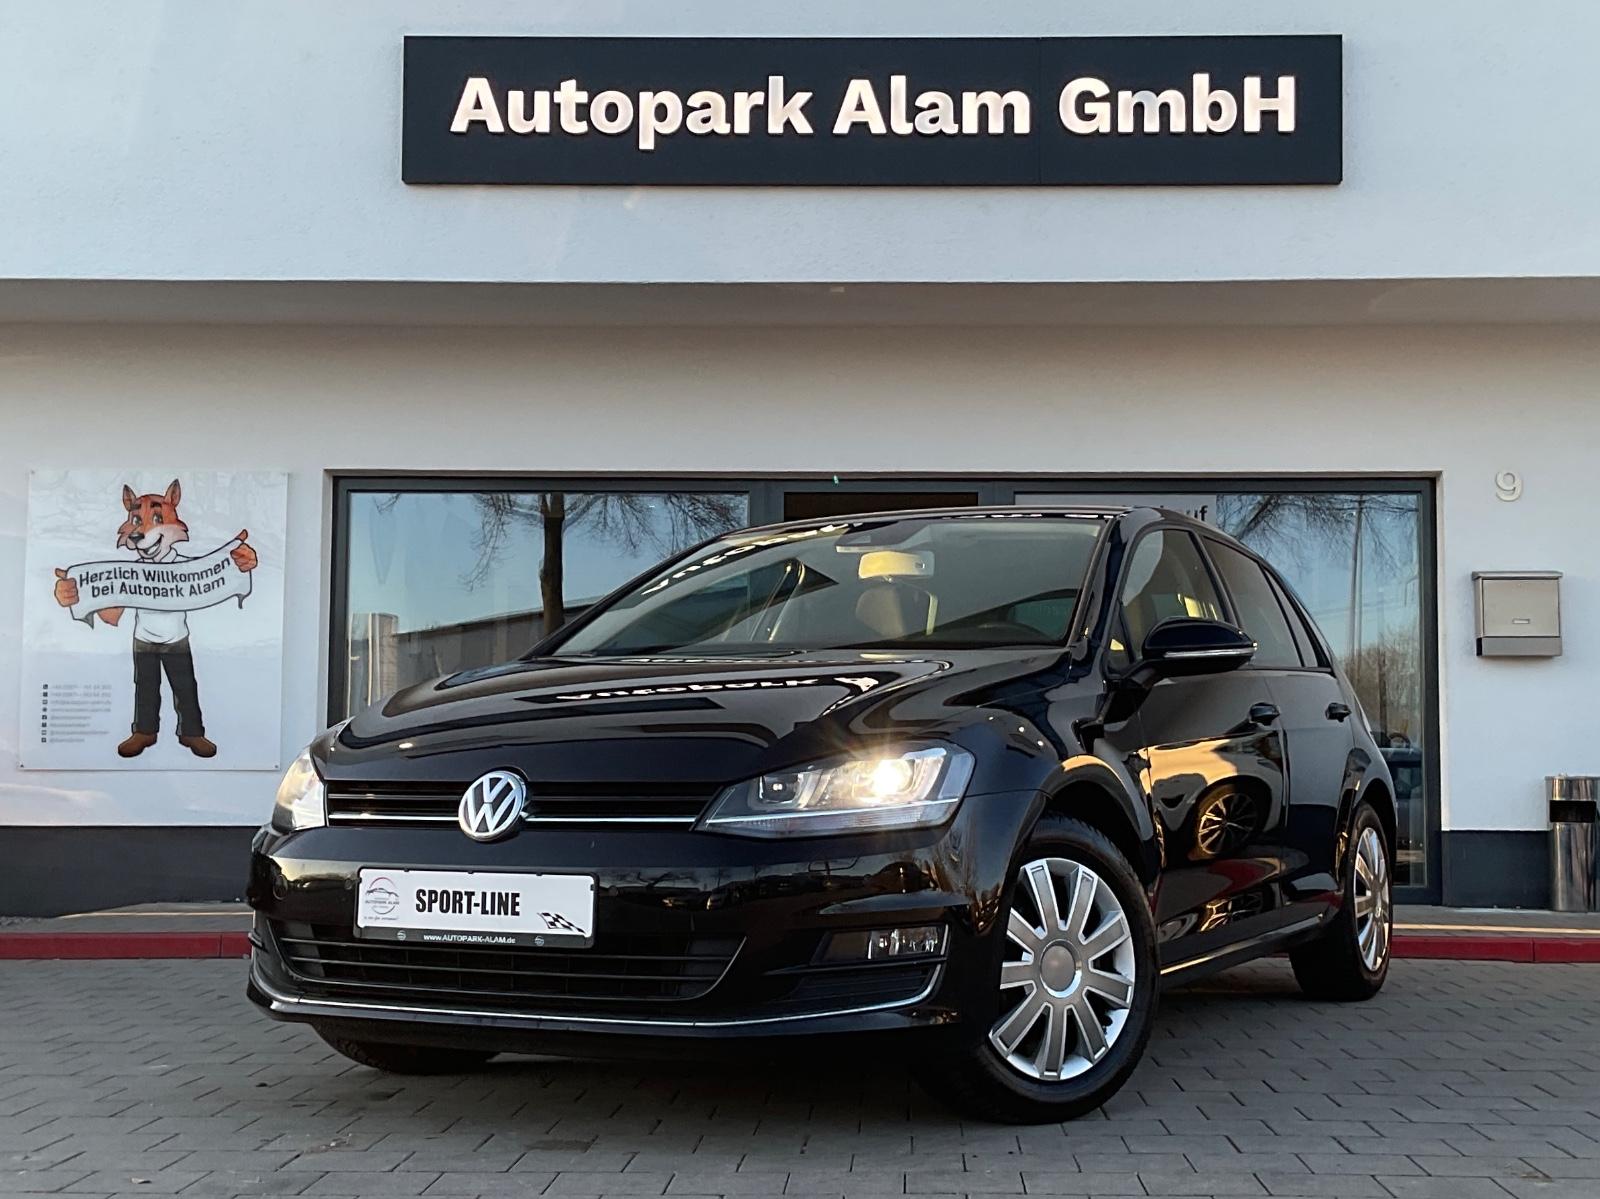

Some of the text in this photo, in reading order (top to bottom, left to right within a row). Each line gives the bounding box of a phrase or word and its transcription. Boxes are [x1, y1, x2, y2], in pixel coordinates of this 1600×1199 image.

[450, 73, 1296, 151] Autopark Alam GmbH
[1495, 471, 1523, 502] 9
[79, 556, 231, 588] Herzlich Willkommen
[91, 576, 226, 599] bei Autopark Alam
[415, 888, 521, 917] SPORT-LINE
[423, 933, 516, 945] www.AUTOPARK-ALAM.de
